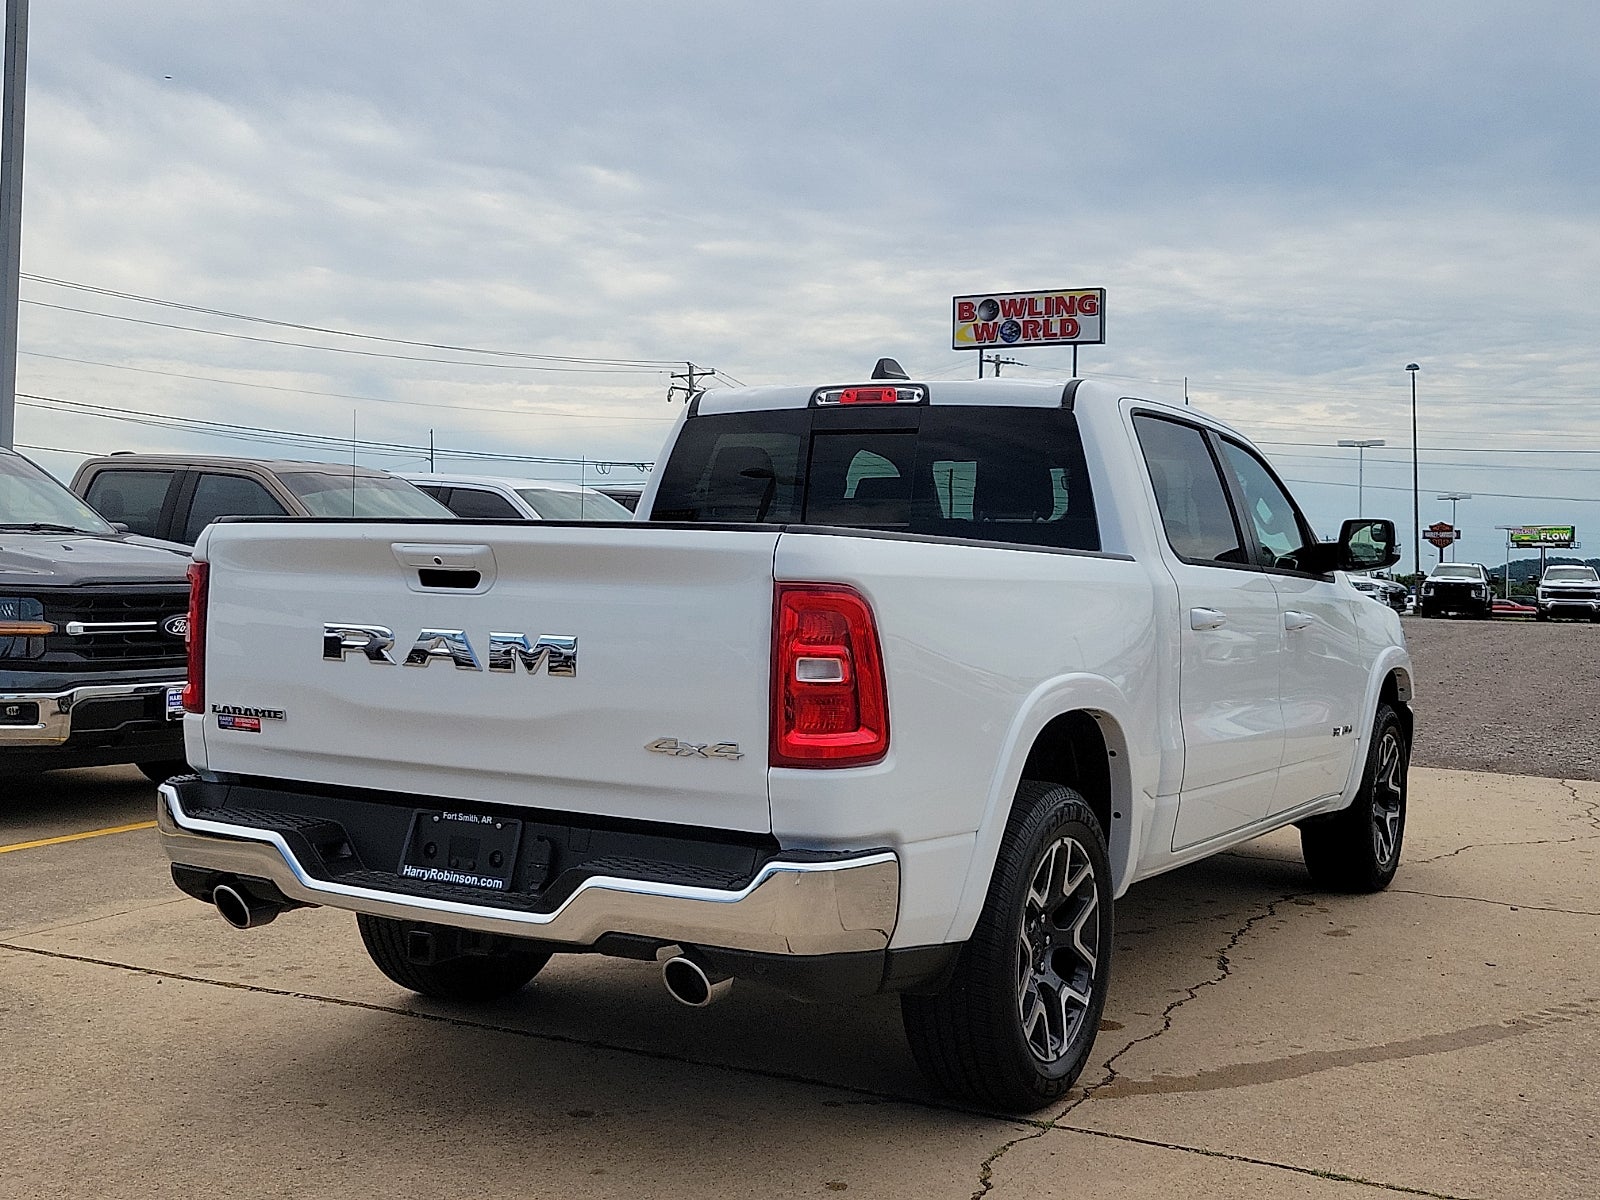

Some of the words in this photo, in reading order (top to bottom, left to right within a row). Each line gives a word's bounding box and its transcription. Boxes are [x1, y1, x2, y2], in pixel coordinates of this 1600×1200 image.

[957, 294, 1099, 323] BOWLING
[972, 317, 1081, 343] WORLD
[1540, 532, 1570, 541] FLOW
[322, 621, 579, 677] RAM
[211, 702, 287, 721] LARAMIE
[443, 811, 458, 821] Fort
[458, 812, 480, 825] Smith,
[481, 816, 493, 824] AR
[402, 864, 503, 889] HarryRobinson.com
